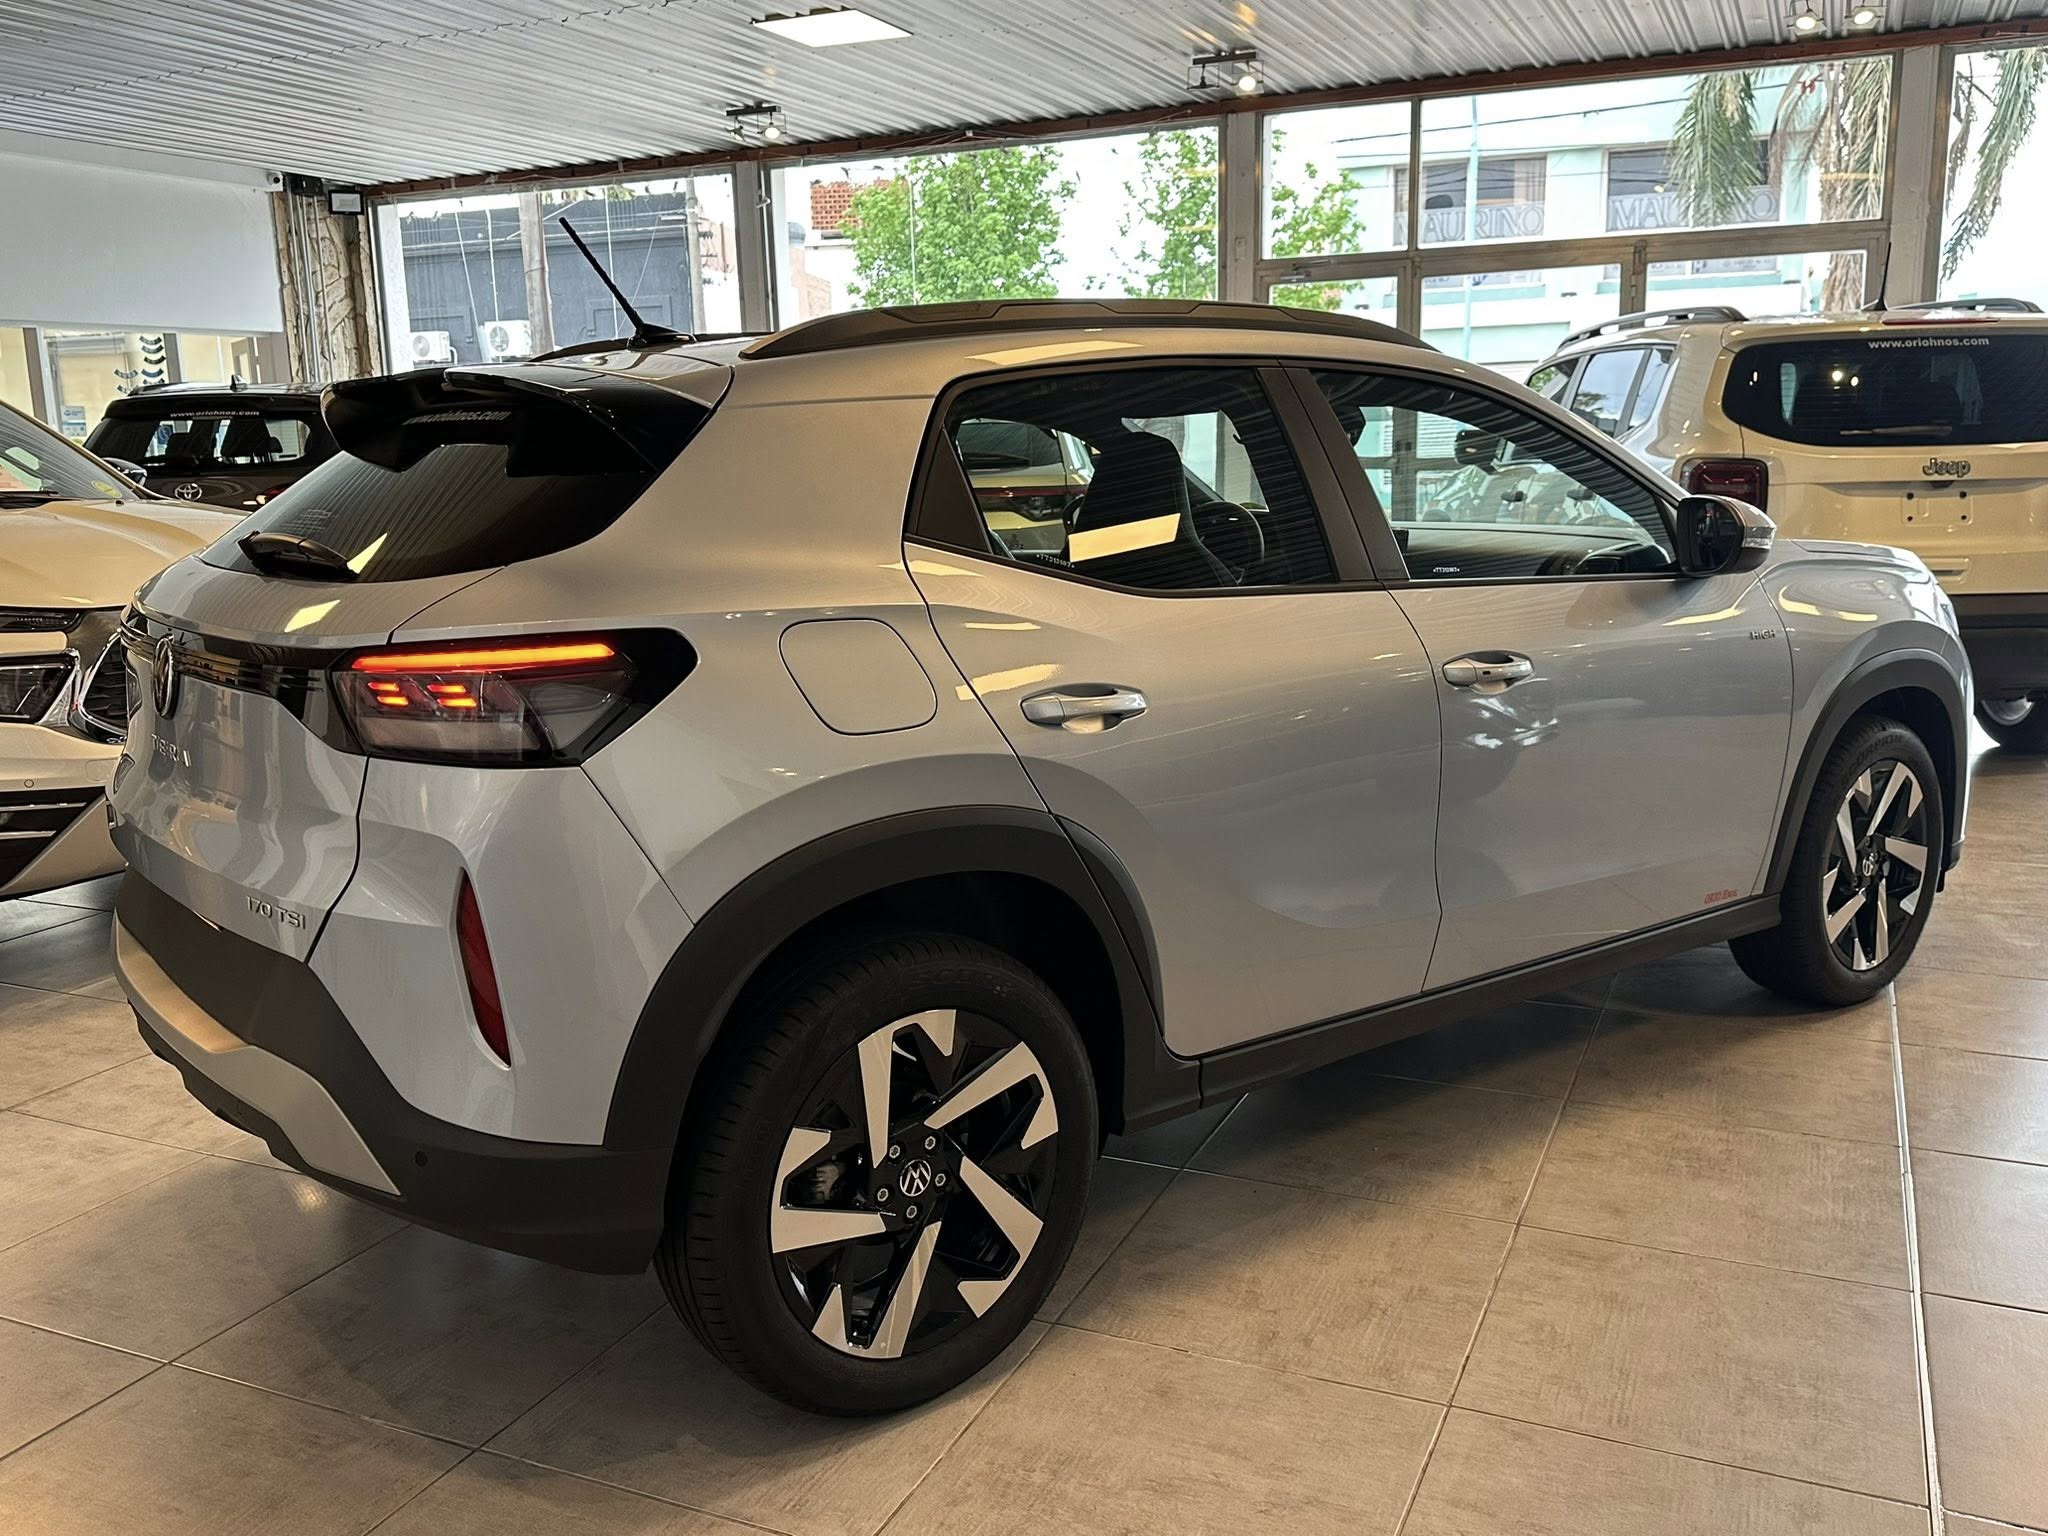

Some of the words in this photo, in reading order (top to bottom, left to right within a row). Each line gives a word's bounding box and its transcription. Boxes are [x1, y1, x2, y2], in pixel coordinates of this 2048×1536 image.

[1867, 337, 1990, 349] www.oriohnos.com
[1922, 457, 1971, 479] Jeep
[1749, 629, 1776, 640] HIGH
[246, 895, 273, 918] 170
[274, 905, 306, 930] TSI
